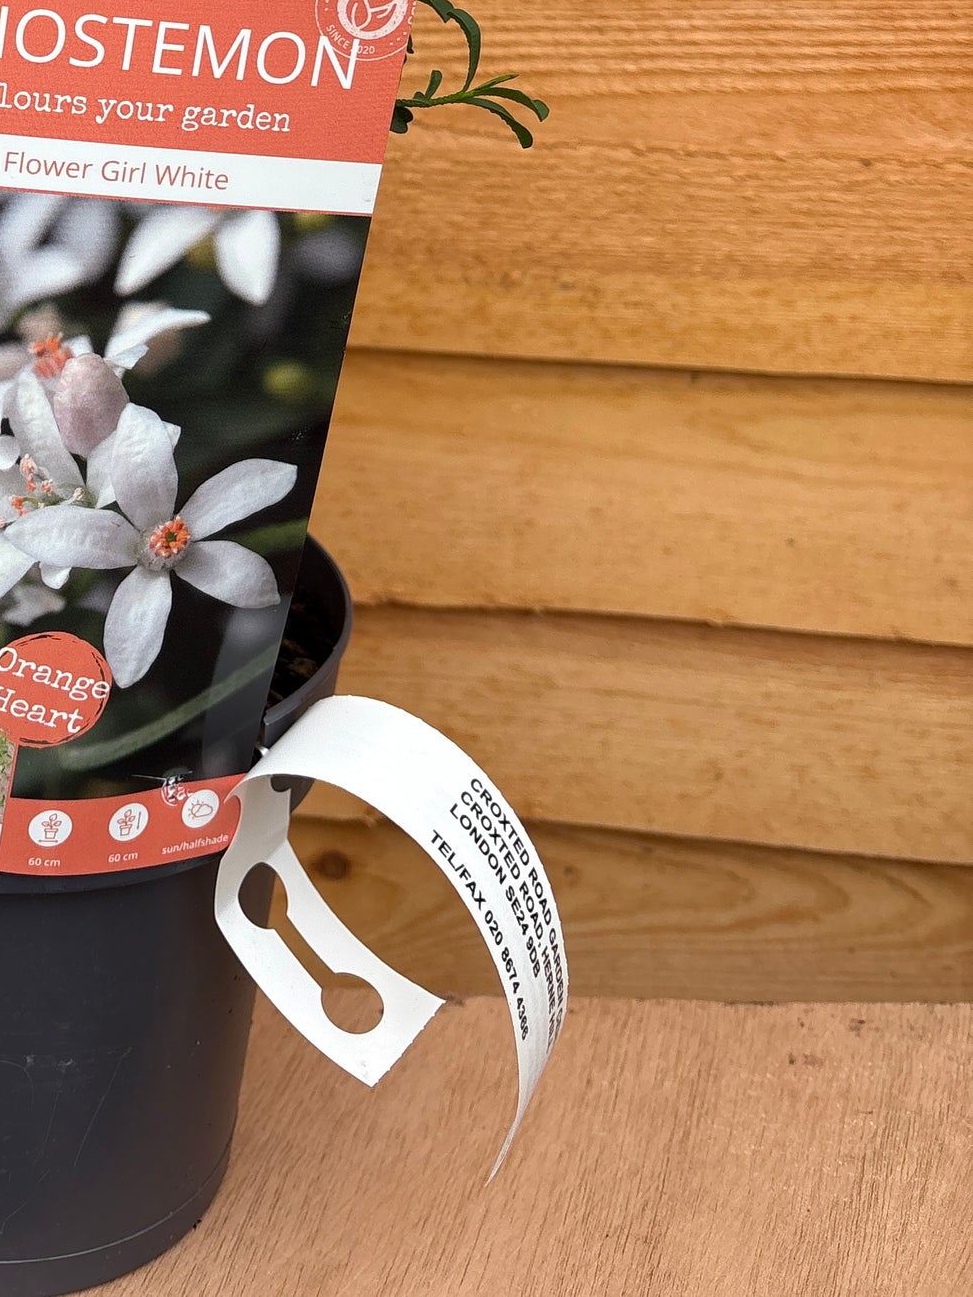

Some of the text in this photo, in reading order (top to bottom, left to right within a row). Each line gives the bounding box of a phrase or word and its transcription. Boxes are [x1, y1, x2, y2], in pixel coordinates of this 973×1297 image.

[326, 24, 376, 55] SINCE 020
[96, 98, 174, 124] your
[181, 103, 292, 133] garden
[3, 151, 230, 191] Flower Girl White
[161, 833, 230, 855] sun/halfshade
[460, 791, 520, 880] CROXTED
[470, 778, 530, 866] CROXTED
[528, 867, 552, 926] ROAD
[28, 857, 61, 867] 60 cm
[108, 853, 139, 863] 60 cm
[449, 803, 541, 978] LONDON SE24 9DB
[430, 829, 487, 911] TEL/FAX
[484, 909, 504, 946] 020
[500, 947, 521, 995] 8674
